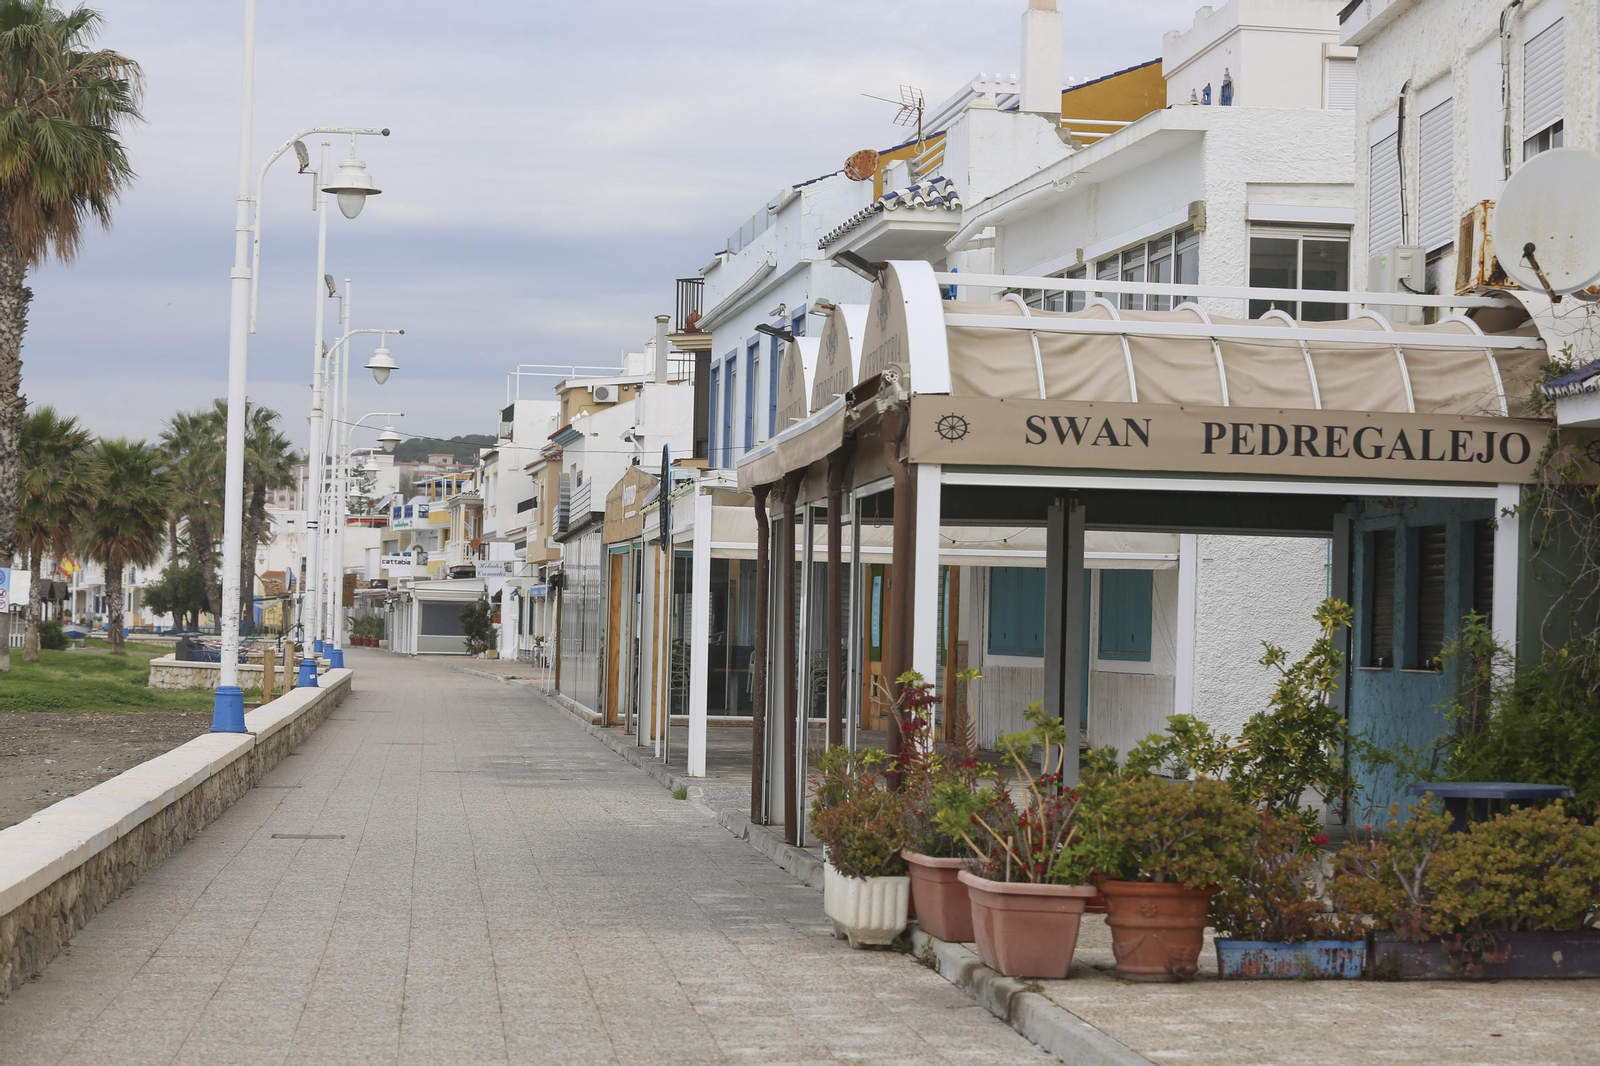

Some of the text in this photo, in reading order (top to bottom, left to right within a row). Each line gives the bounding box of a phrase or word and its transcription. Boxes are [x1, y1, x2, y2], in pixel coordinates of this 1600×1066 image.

[1025, 415, 1531, 465] SWAN PEDREGALEJO
[381, 558, 411, 566] cattabia
